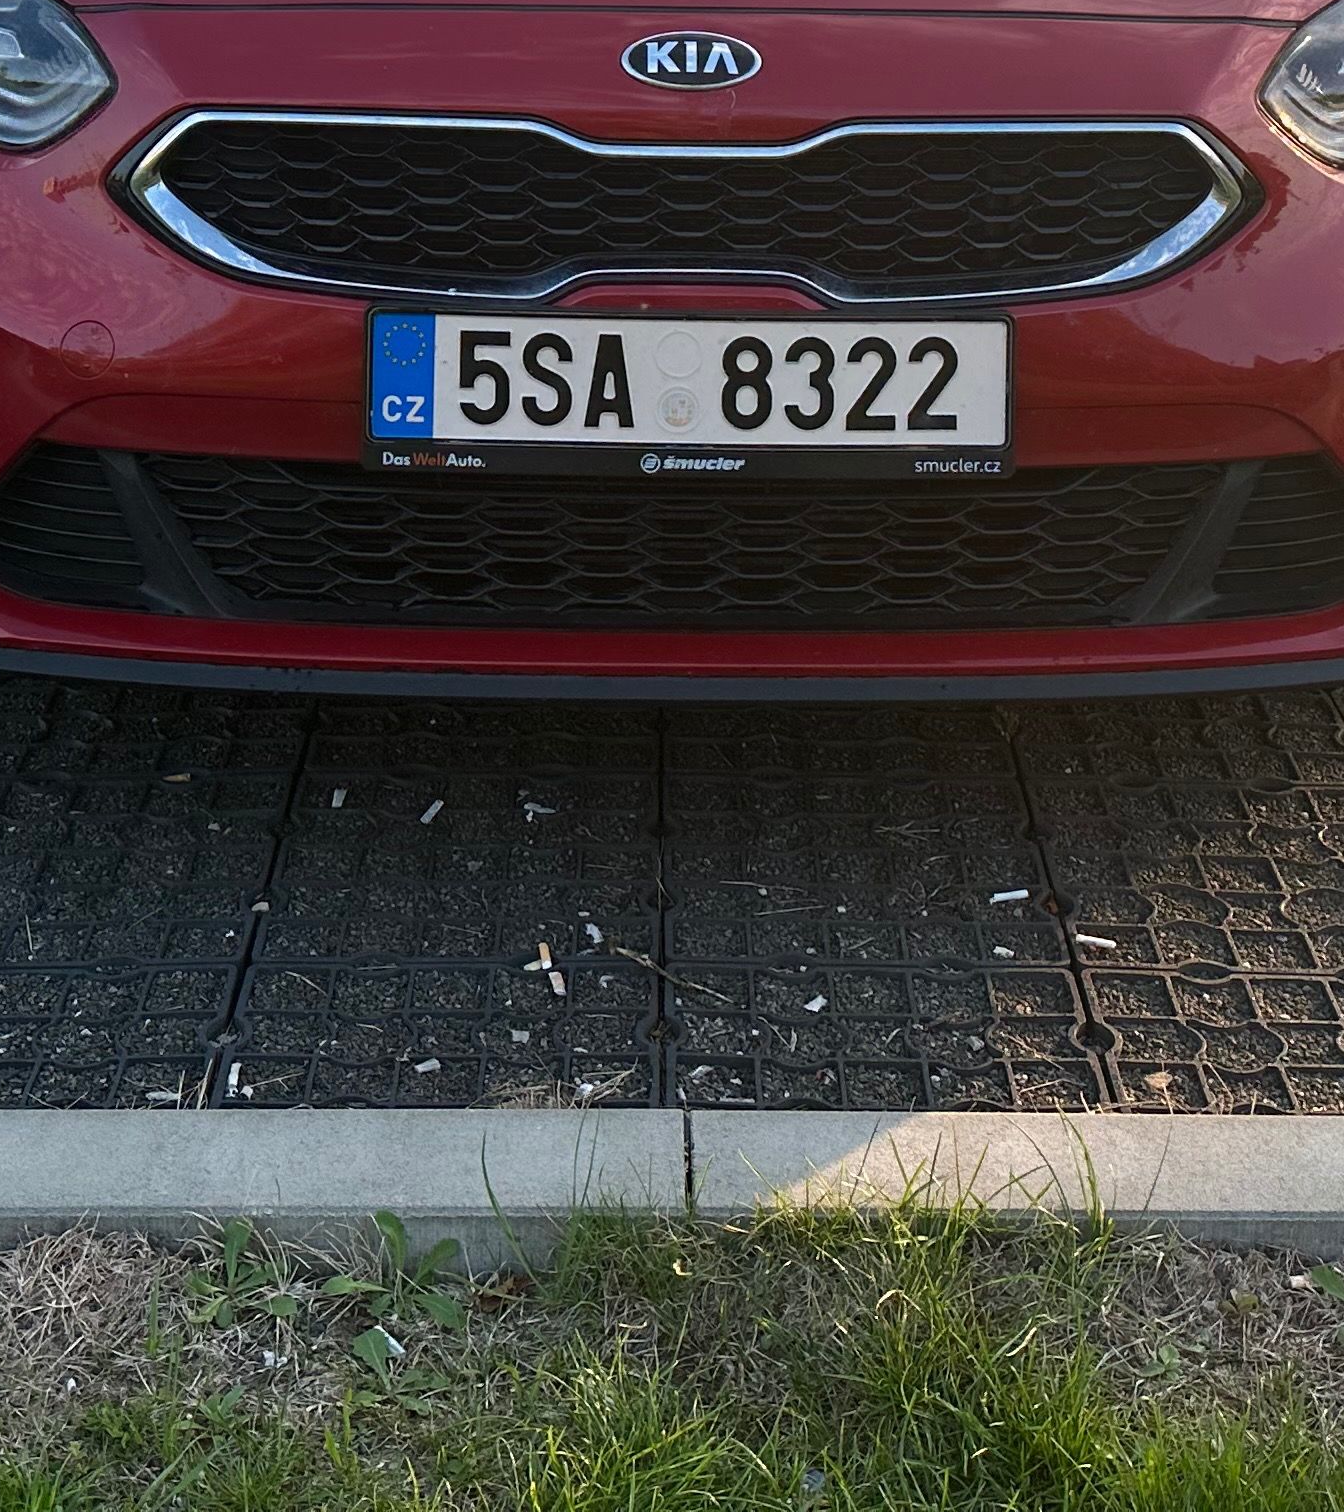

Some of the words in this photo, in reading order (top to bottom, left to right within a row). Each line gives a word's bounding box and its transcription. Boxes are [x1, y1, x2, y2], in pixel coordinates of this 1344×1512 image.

[646, 41, 739, 75] KIA
[459, 331, 634, 428] 5SA
[721, 336, 958, 431] 8322
[382, 395, 425, 423] CZ
[382, 451, 411, 466] Das
[914, 458, 1002, 473] smucler.cz
